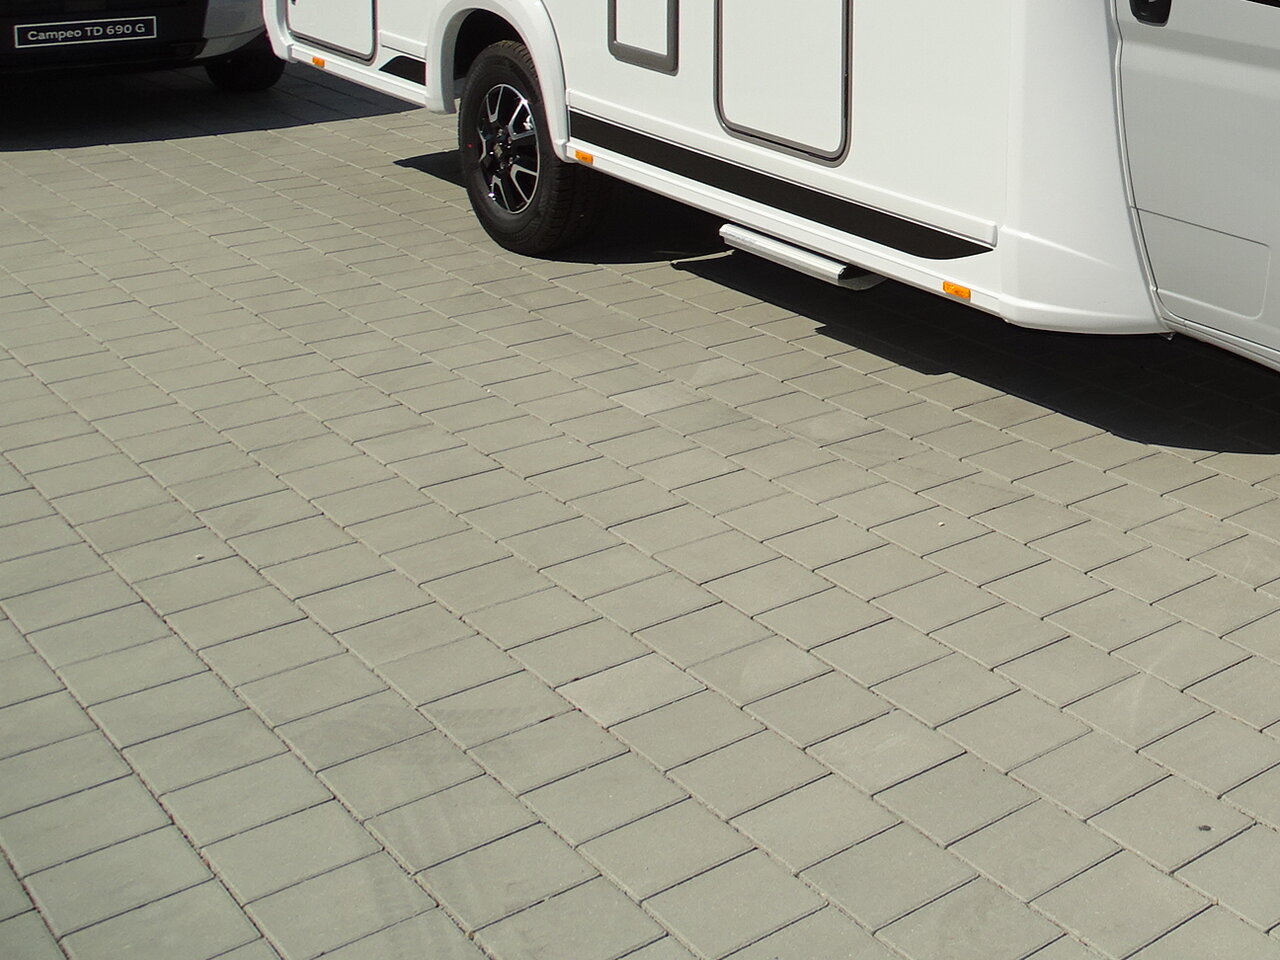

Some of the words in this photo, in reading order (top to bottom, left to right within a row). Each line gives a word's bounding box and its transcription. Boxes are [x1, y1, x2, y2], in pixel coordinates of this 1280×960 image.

[27, 29, 82, 42] Campeo
[85, 26, 103, 37] TD
[106, 23, 132, 35] 690
[135, 22, 146, 34] G
